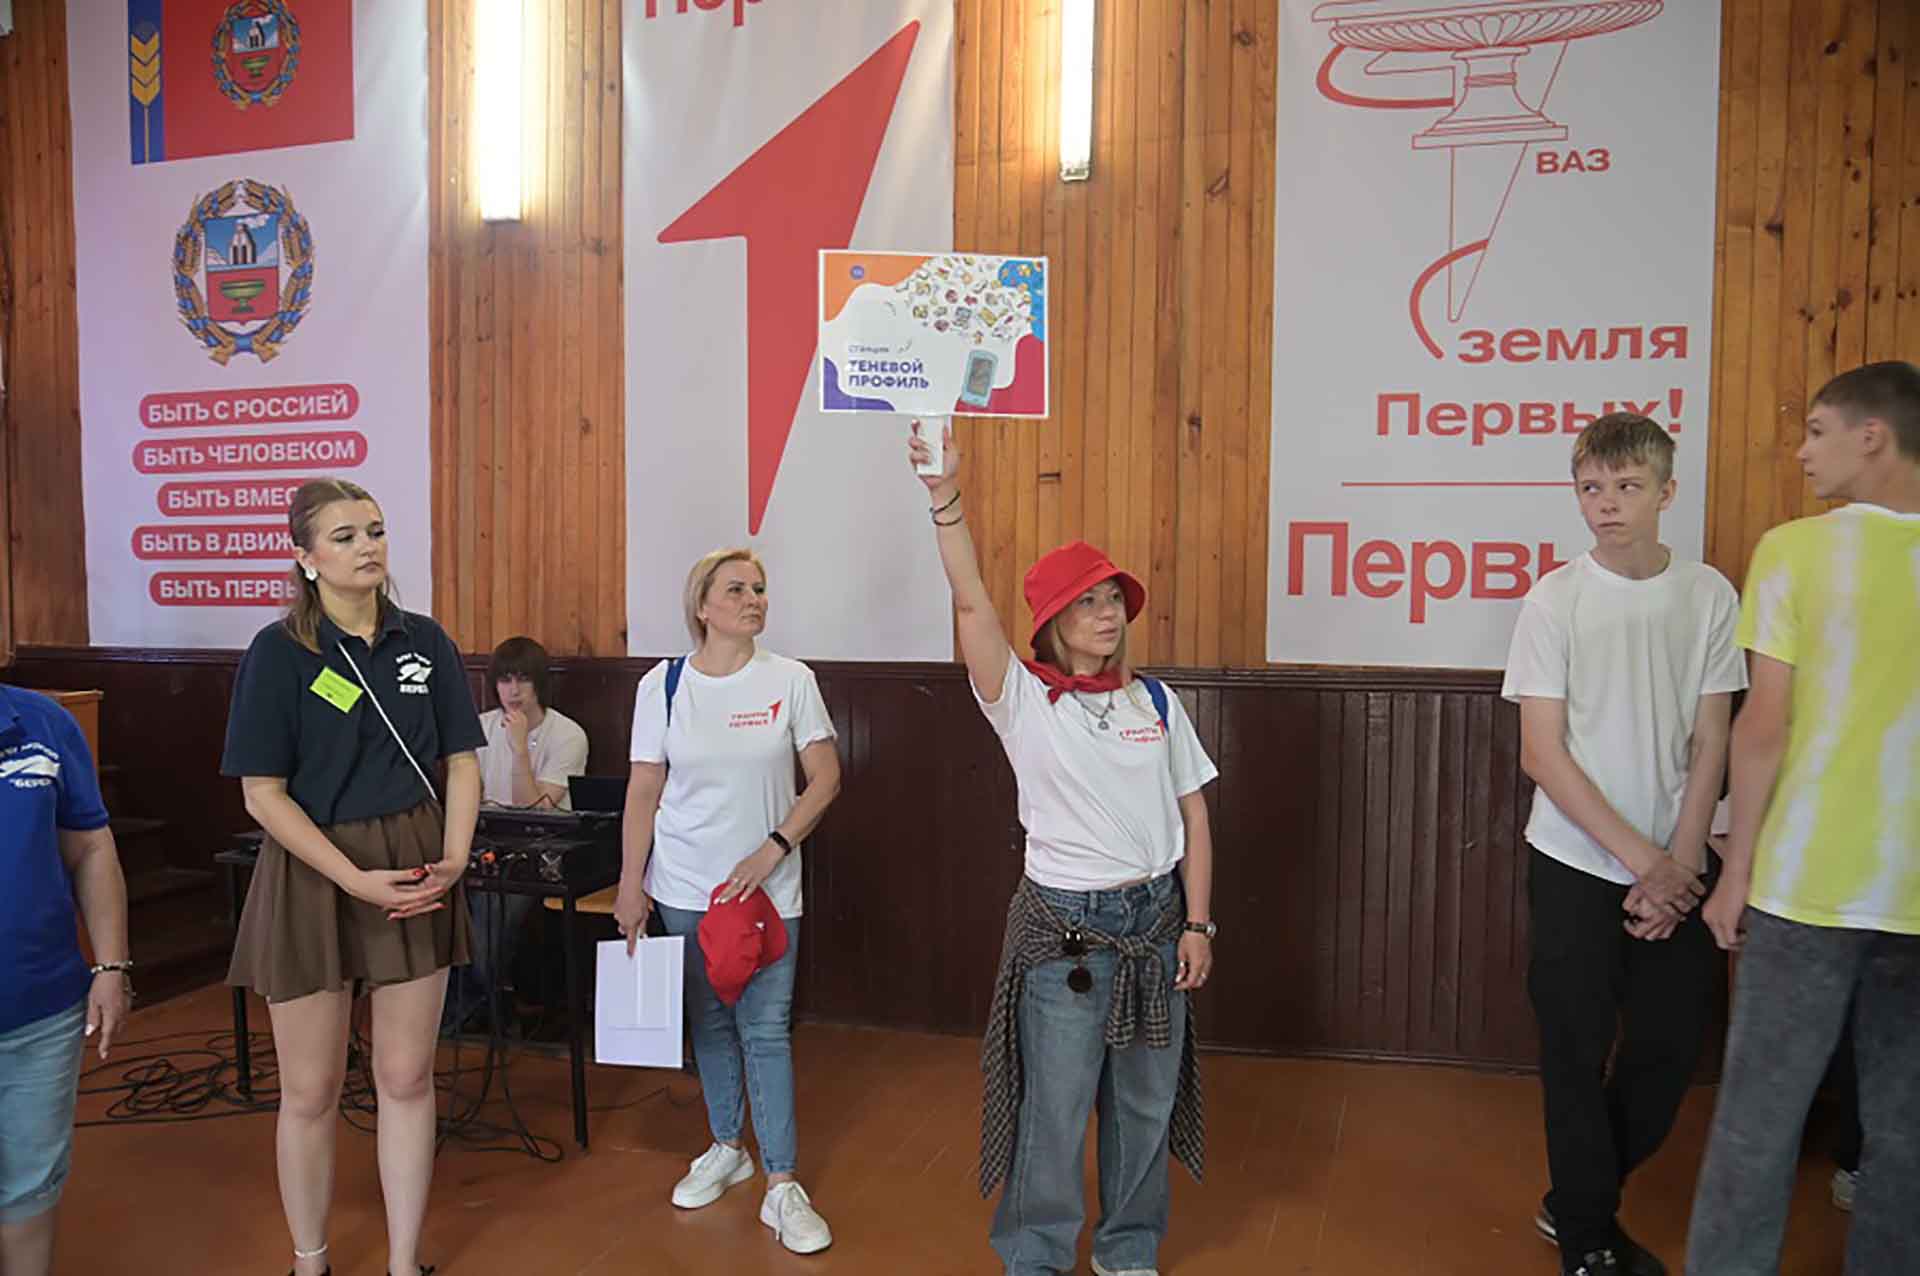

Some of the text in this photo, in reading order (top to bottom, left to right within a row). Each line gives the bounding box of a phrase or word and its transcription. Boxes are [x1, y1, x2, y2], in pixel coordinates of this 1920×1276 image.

[1536, 148, 1611, 174] ВАЗ
[1457, 325, 1689, 364] земля
[848, 358, 923, 374] ТЕНЕВОЙ
[848, 374, 930, 388] ПРОФИЛЬ
[148, 389, 349, 423] БЫТЬ С РОССИЕЙ
[143, 439, 356, 467] БЫТЬ ЧЕЛОВЕКОМ
[167, 490, 230, 509] БЫТЬ
[141, 534, 201, 553] БЫТЬ
[206, 533, 221, 551] В
[159, 579, 221, 598] БЫТЬ
